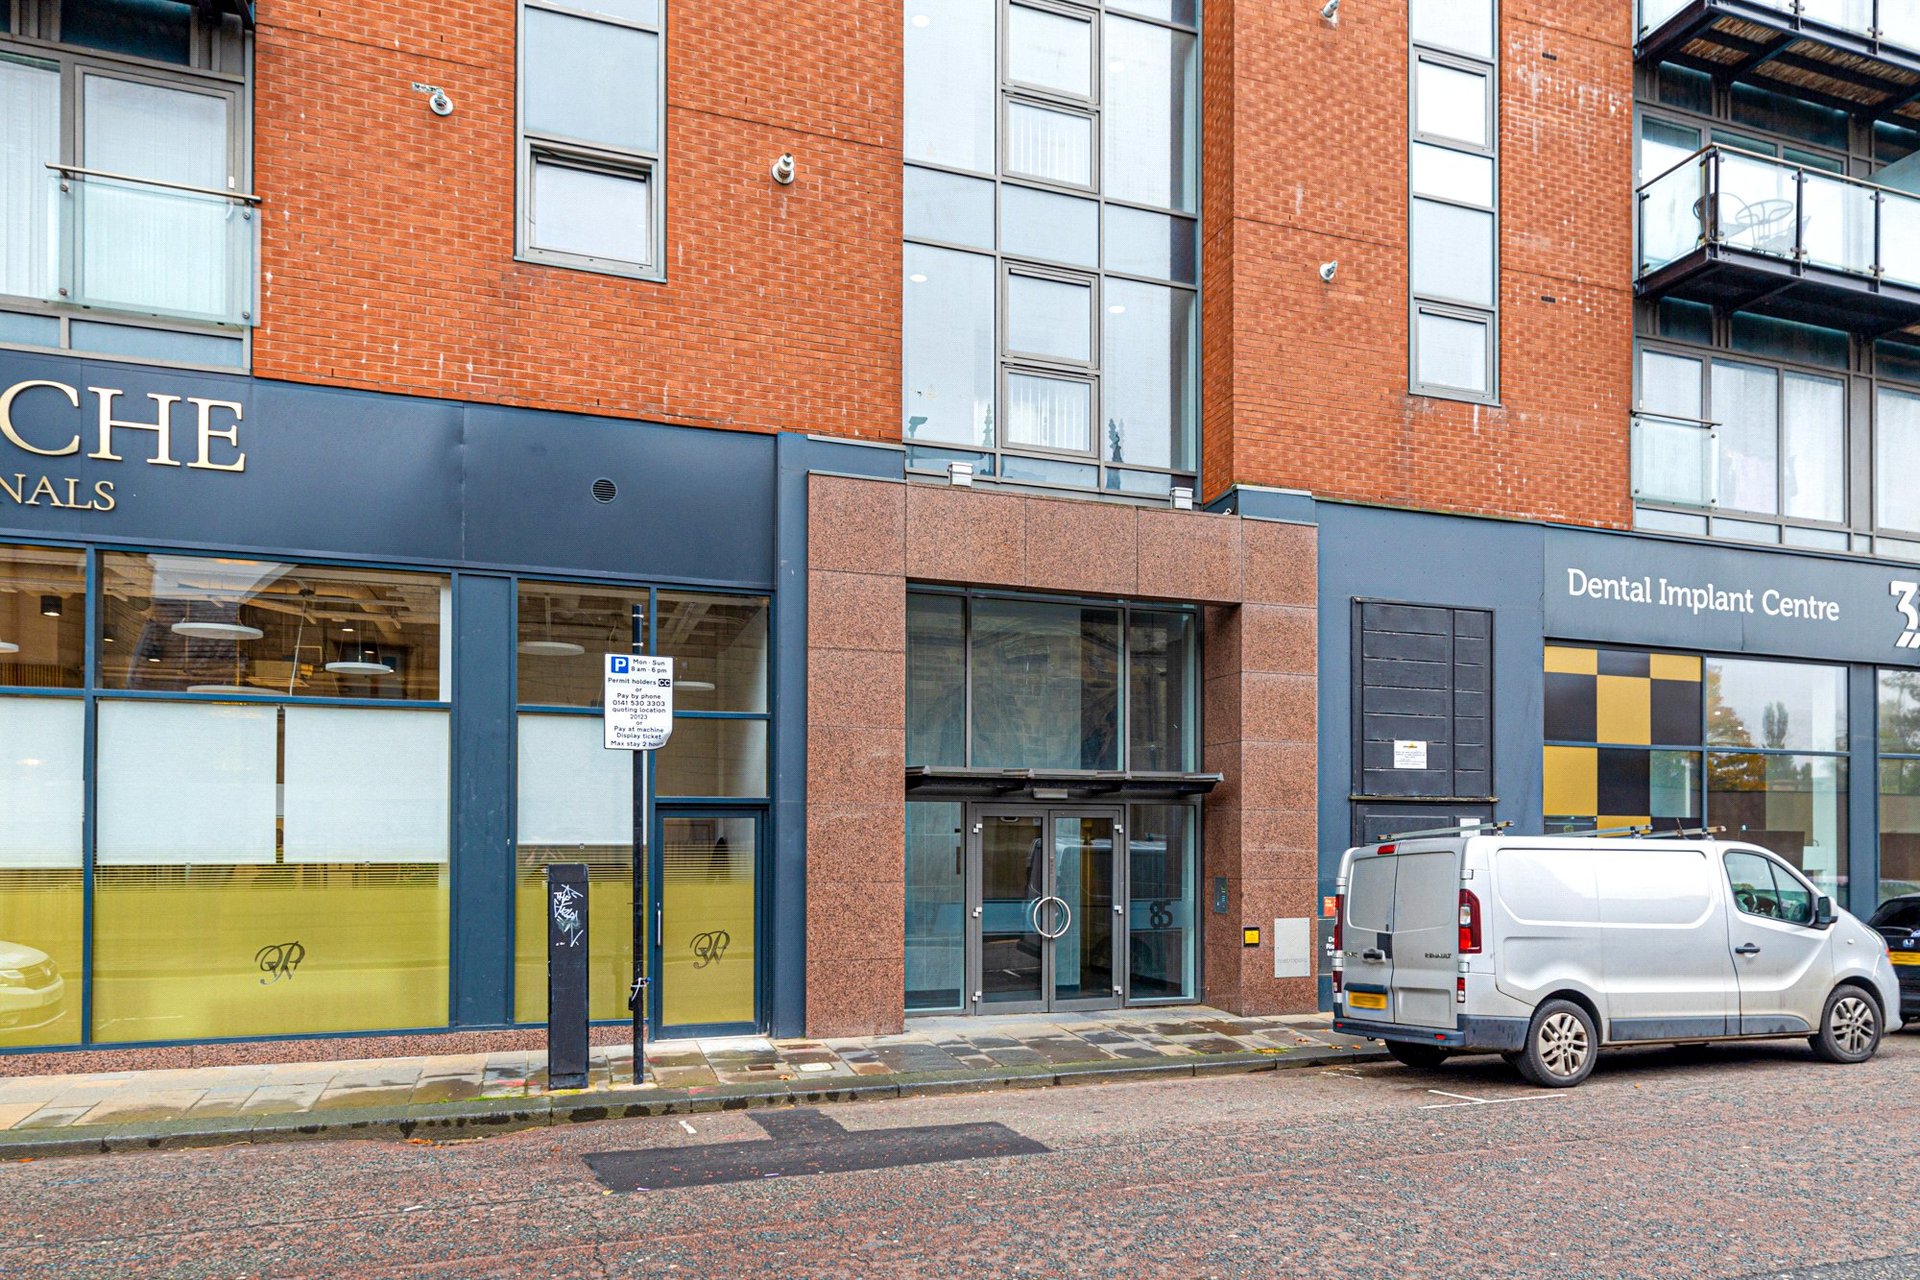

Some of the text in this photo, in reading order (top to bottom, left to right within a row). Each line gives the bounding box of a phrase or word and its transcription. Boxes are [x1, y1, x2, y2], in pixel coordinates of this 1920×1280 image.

[0, 380, 246, 472] CHE
[1567, 568, 1840, 621] Dental Implant Centre
[614, 658, 626, 672] P
[1150, 900, 1174, 928] 85
